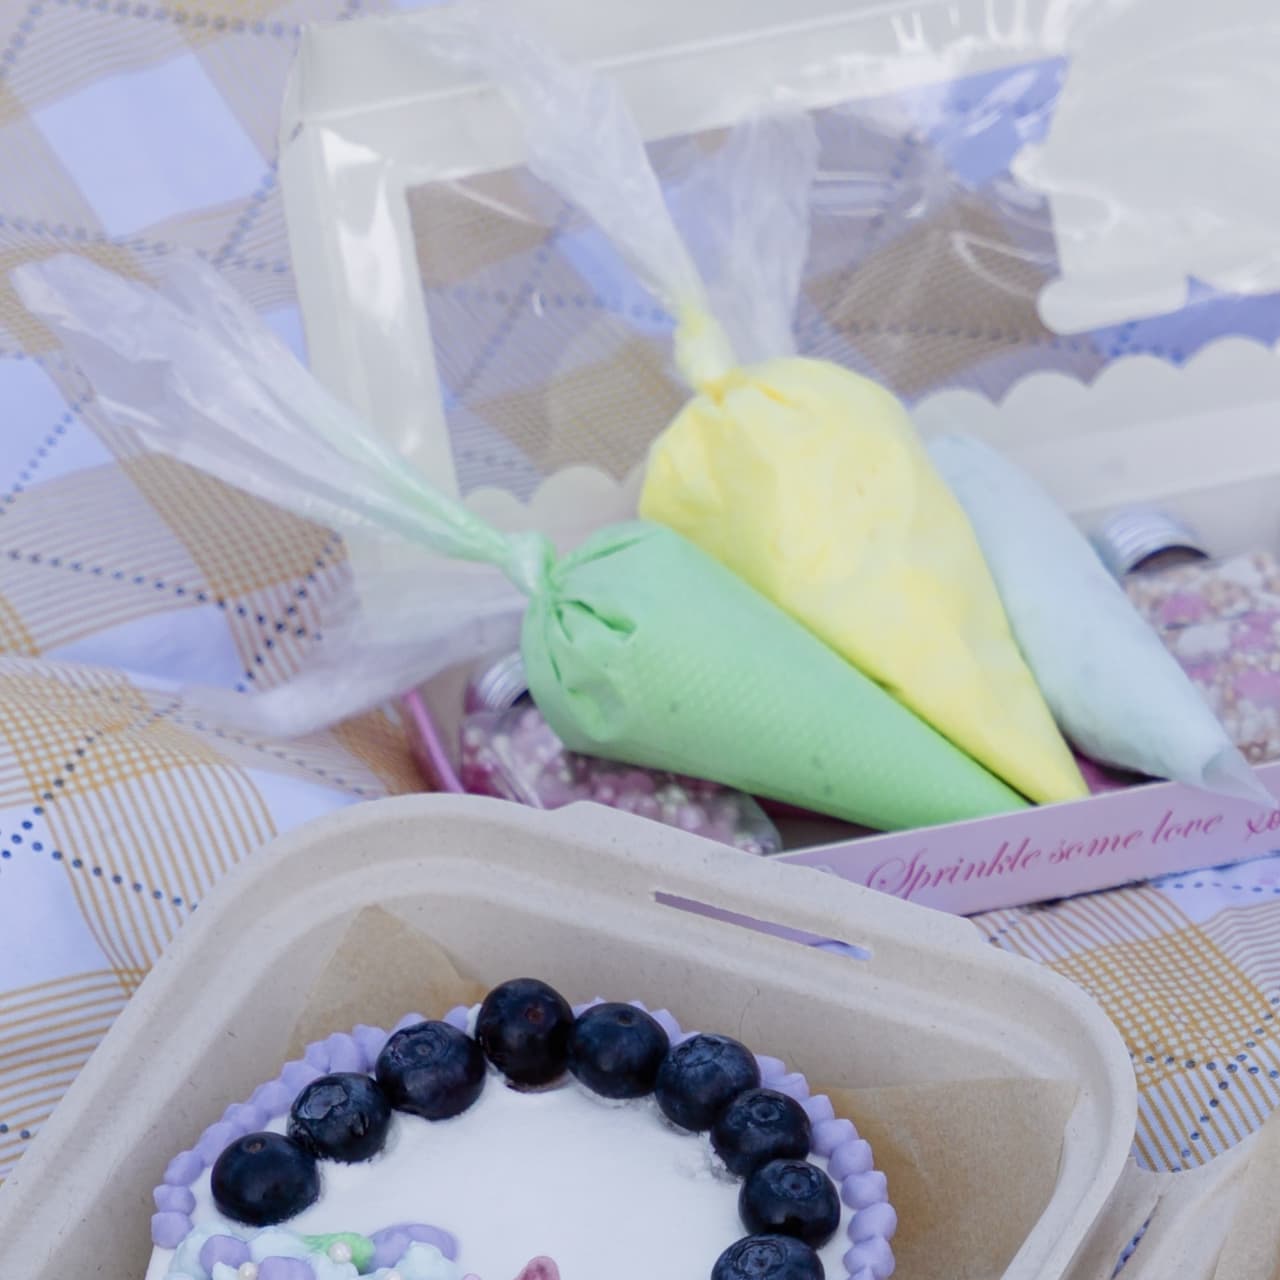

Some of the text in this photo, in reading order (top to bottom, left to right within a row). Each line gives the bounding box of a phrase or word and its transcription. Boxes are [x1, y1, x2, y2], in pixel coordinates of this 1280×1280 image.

[866, 837, 1041, 900] Sprinkle
[1049, 830, 1144, 865] some
[1151, 810, 1224, 845] love
